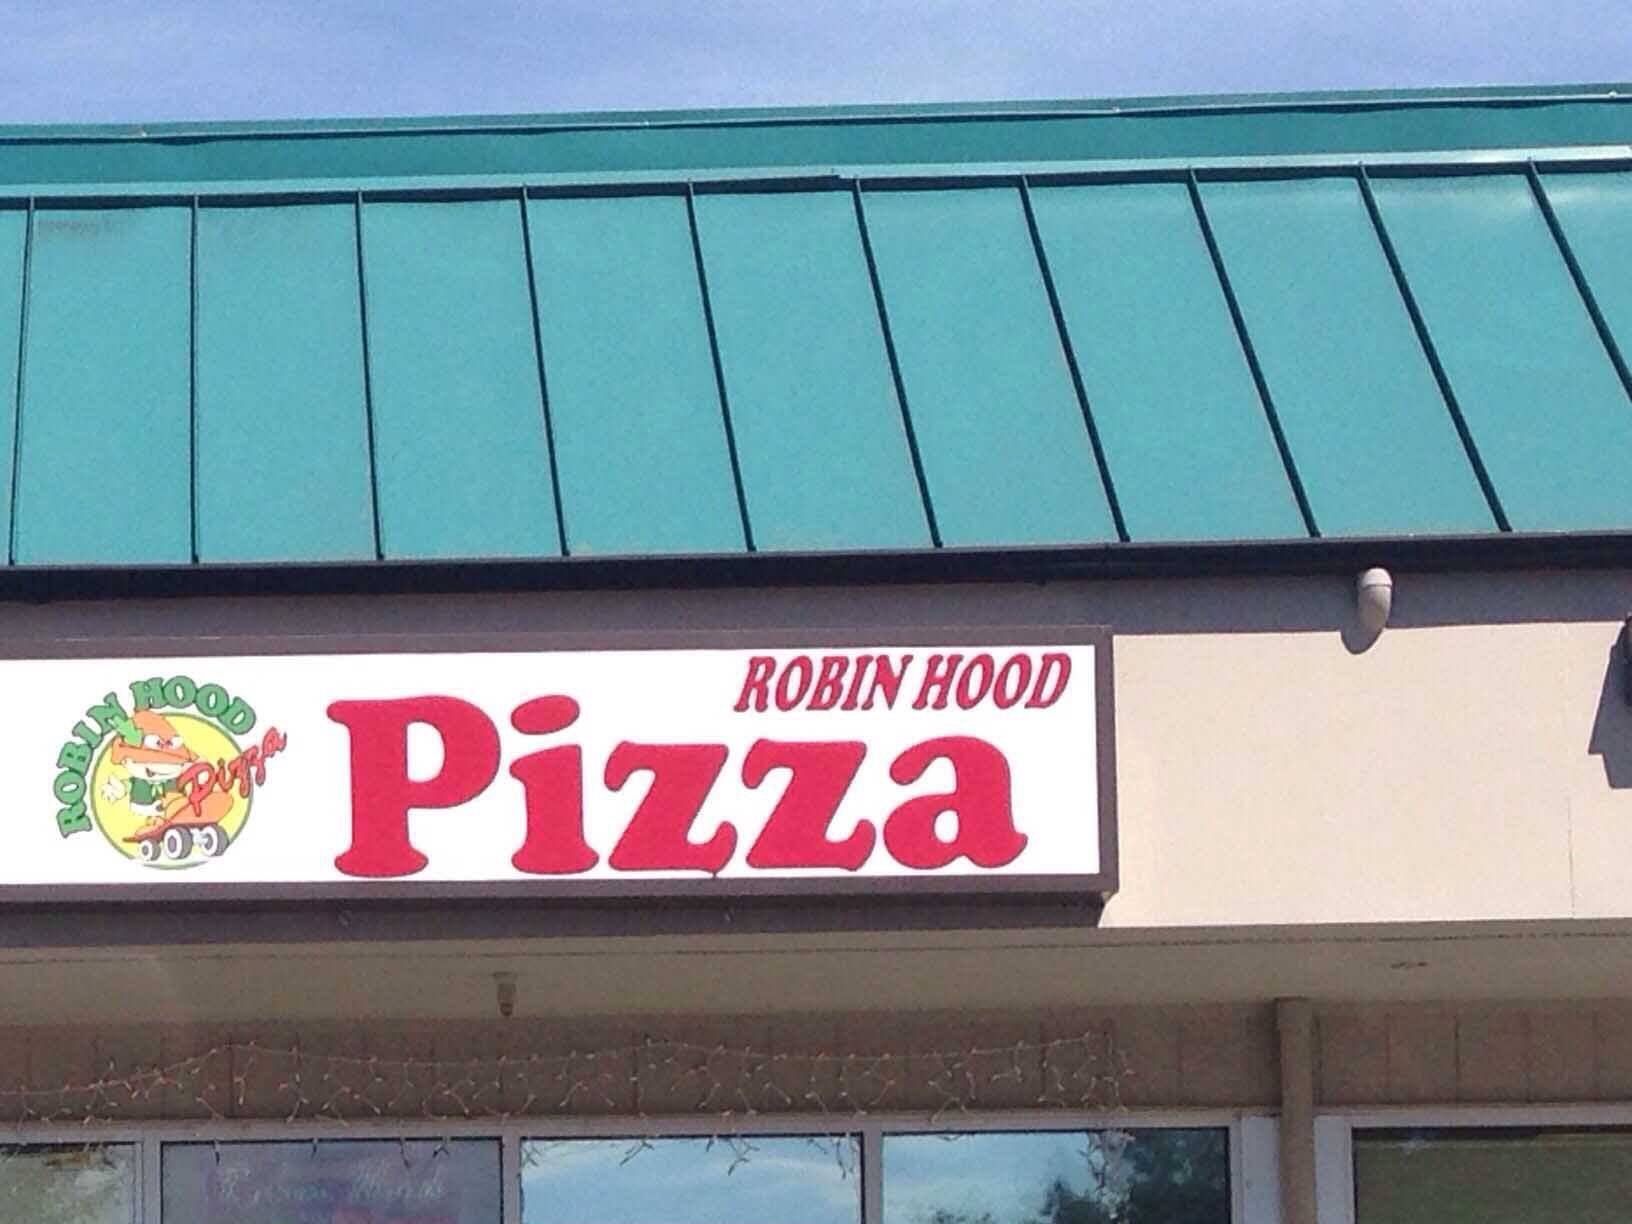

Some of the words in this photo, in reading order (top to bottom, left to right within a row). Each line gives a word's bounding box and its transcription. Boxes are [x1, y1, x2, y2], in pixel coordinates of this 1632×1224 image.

[734, 654, 913, 712] ROBIN
[912, 653, 1072, 710] HOOD
[53, 692, 128, 838] ROBIN
[129, 675, 256, 735] HOOD
[176, 726, 288, 817] Pizza
[327, 695, 1028, 878] Pizza
